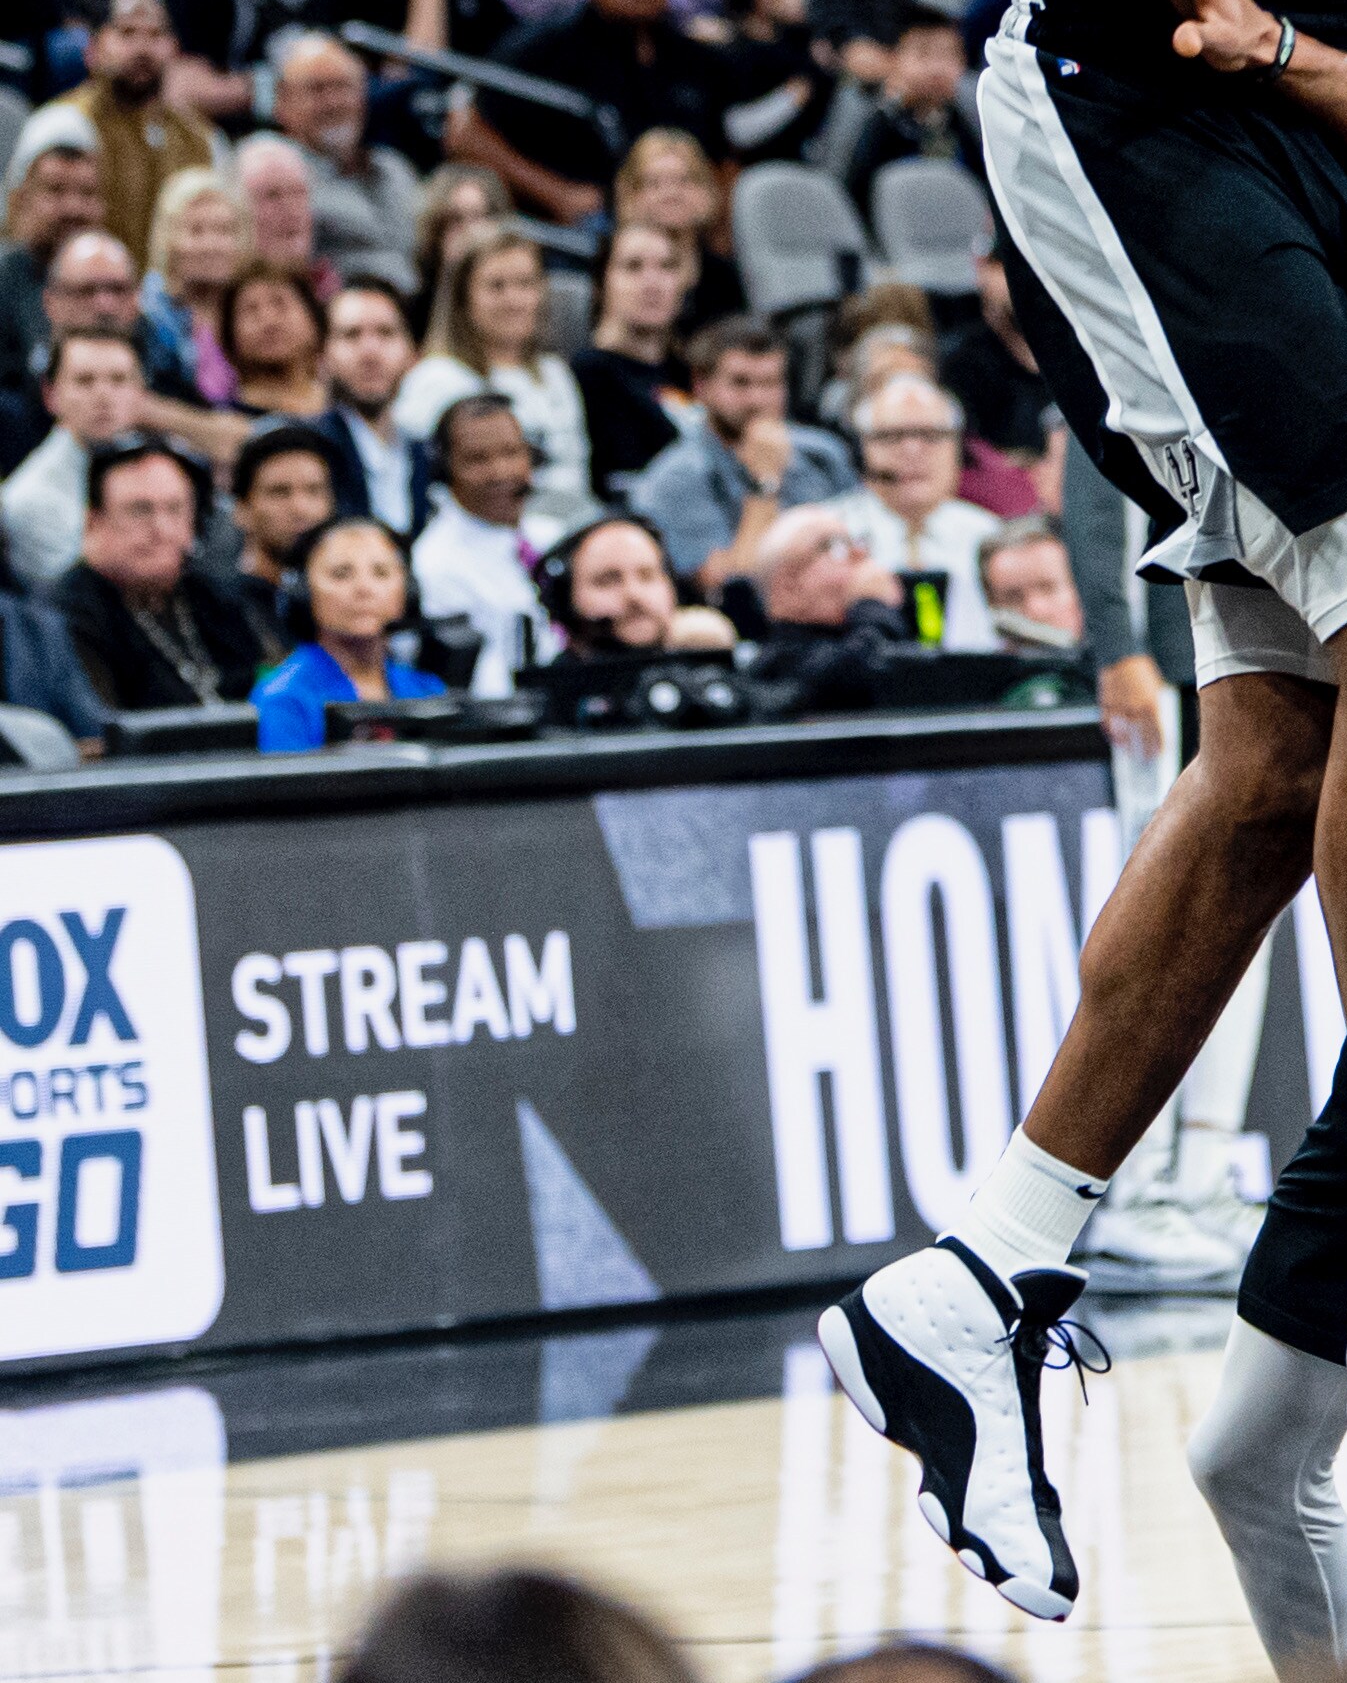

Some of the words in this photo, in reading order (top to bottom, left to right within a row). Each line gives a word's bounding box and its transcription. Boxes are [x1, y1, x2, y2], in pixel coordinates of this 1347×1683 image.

[0, 907, 138, 1047] OX
[231, 929, 577, 1064] STREAM
[243, 1089, 434, 1214] LIVE
